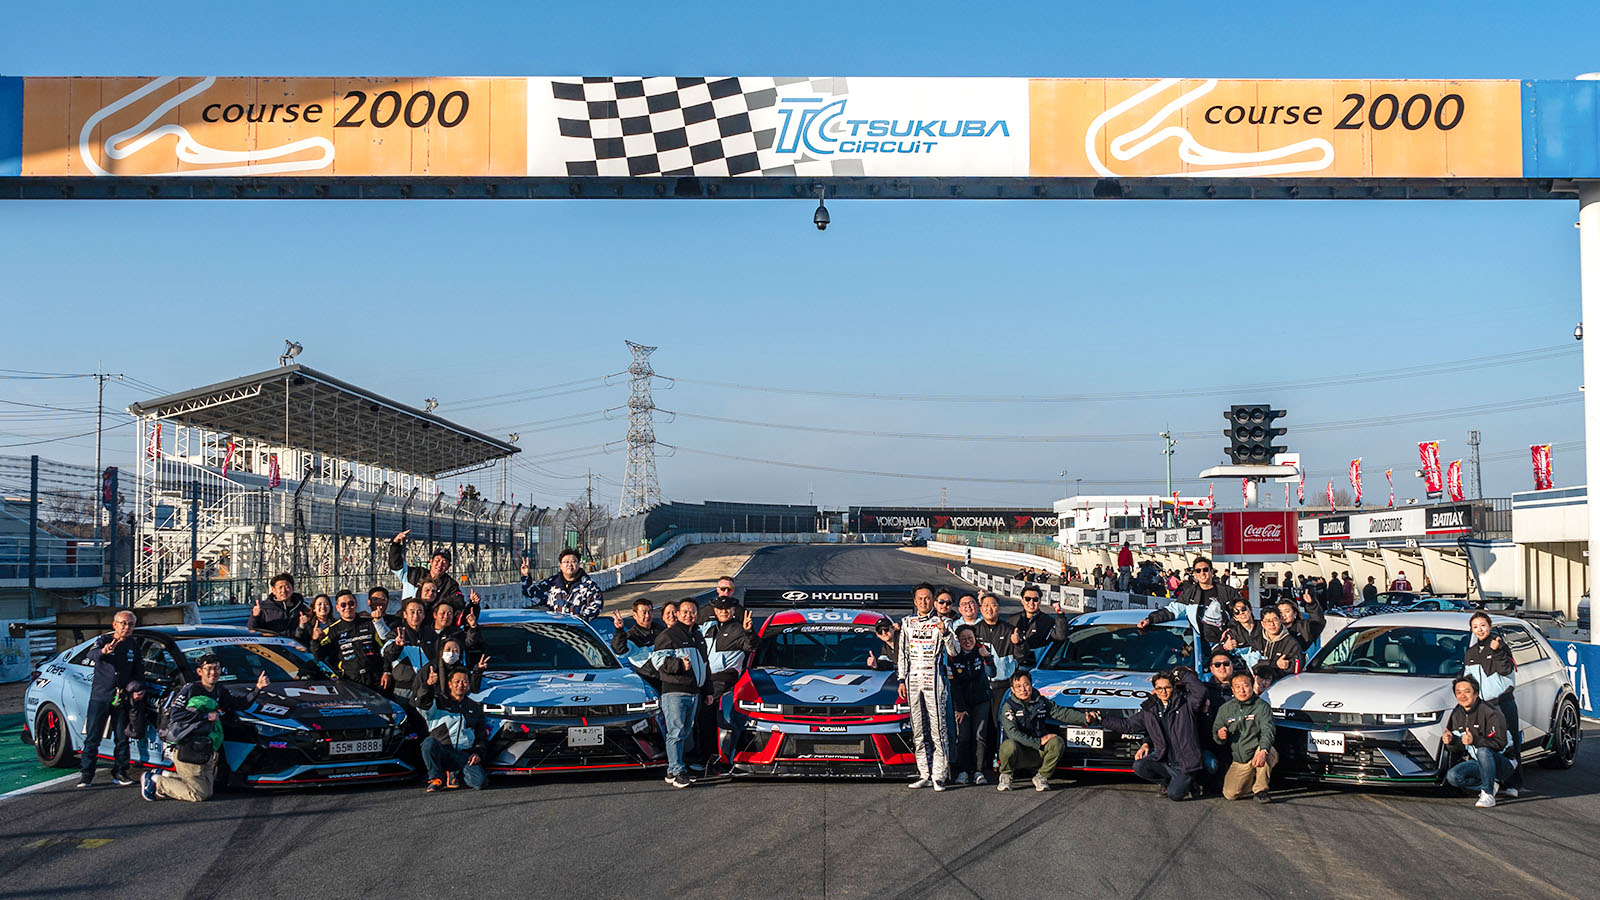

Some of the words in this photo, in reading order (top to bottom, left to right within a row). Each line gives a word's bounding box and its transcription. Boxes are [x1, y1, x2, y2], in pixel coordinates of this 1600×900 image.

[202, 102, 323, 124] course
[333, 90, 470, 128] 2000
[1204, 103, 1323, 126] course
[1333, 94, 1466, 131] 2000
[847, 120, 1010, 137] TSUKUBA
[875, 516, 927, 527] YOKOHAMA
[950, 516, 1005, 527] YOKOHAMA
[1031, 516, 1058, 527] YOKO
[1369, 518, 1402, 533] BRIDGESTONE
[1244, 523, 1283, 538] Coca-Cola
[812, 592, 878, 600] HYUNDAI
[1062, 687, 1152, 698] CUSCO
[597, 734, 603, 743] 5
[1075, 736, 1102, 746] 86-79
[1309, 738, 1330, 746] IONIQ
[356, 741, 378, 752] 8888
